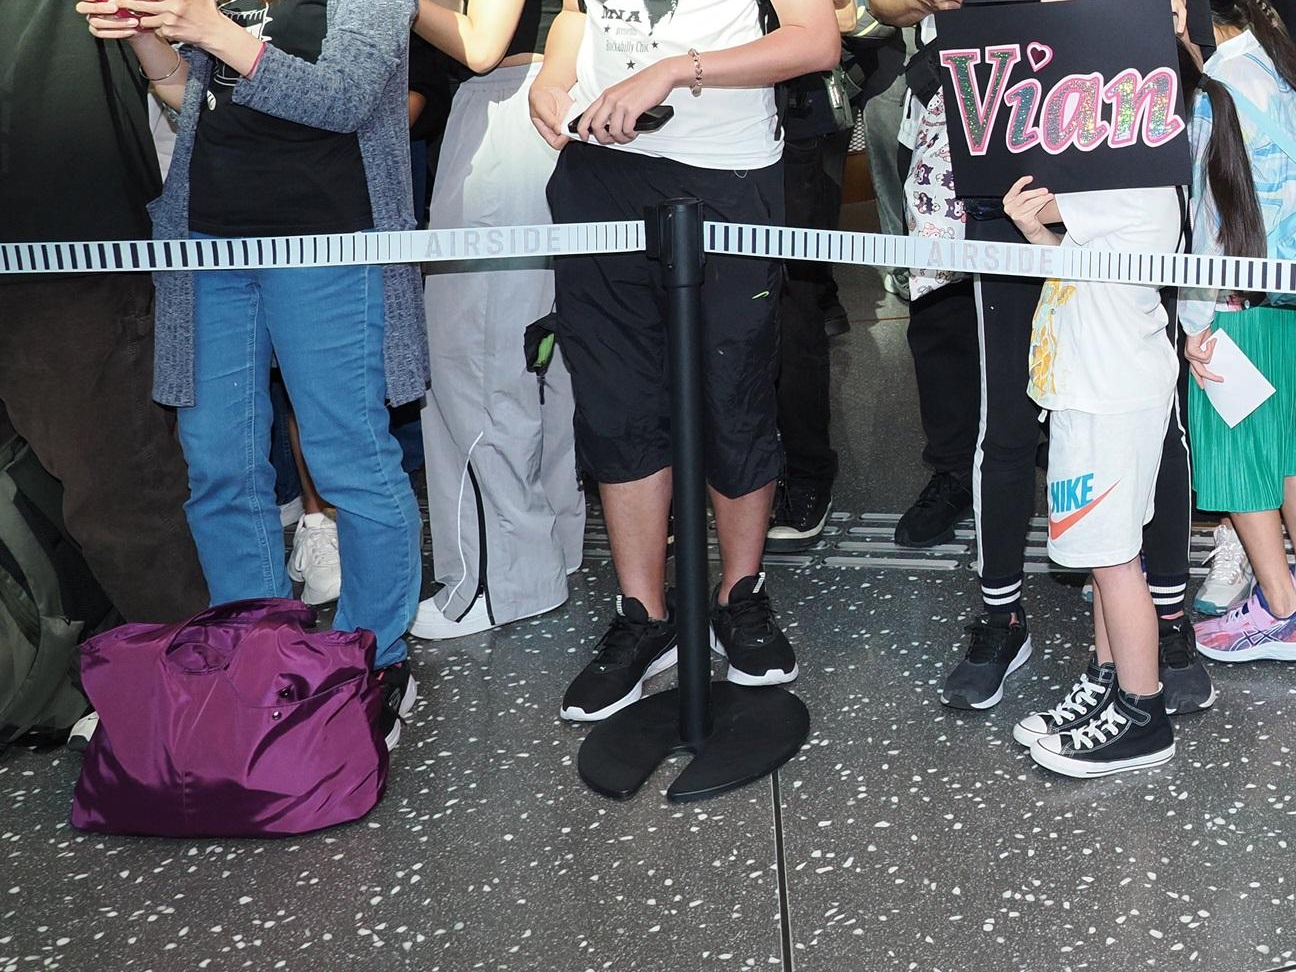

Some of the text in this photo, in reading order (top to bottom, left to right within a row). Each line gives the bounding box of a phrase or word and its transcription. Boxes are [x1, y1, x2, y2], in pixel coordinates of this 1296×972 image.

[939, 42, 1186, 156] Vian
[424, 226, 562, 259] AIRSIDE
[926, 239, 1055, 275] AIRSIDE
[1050, 472, 1095, 514] NIKE
